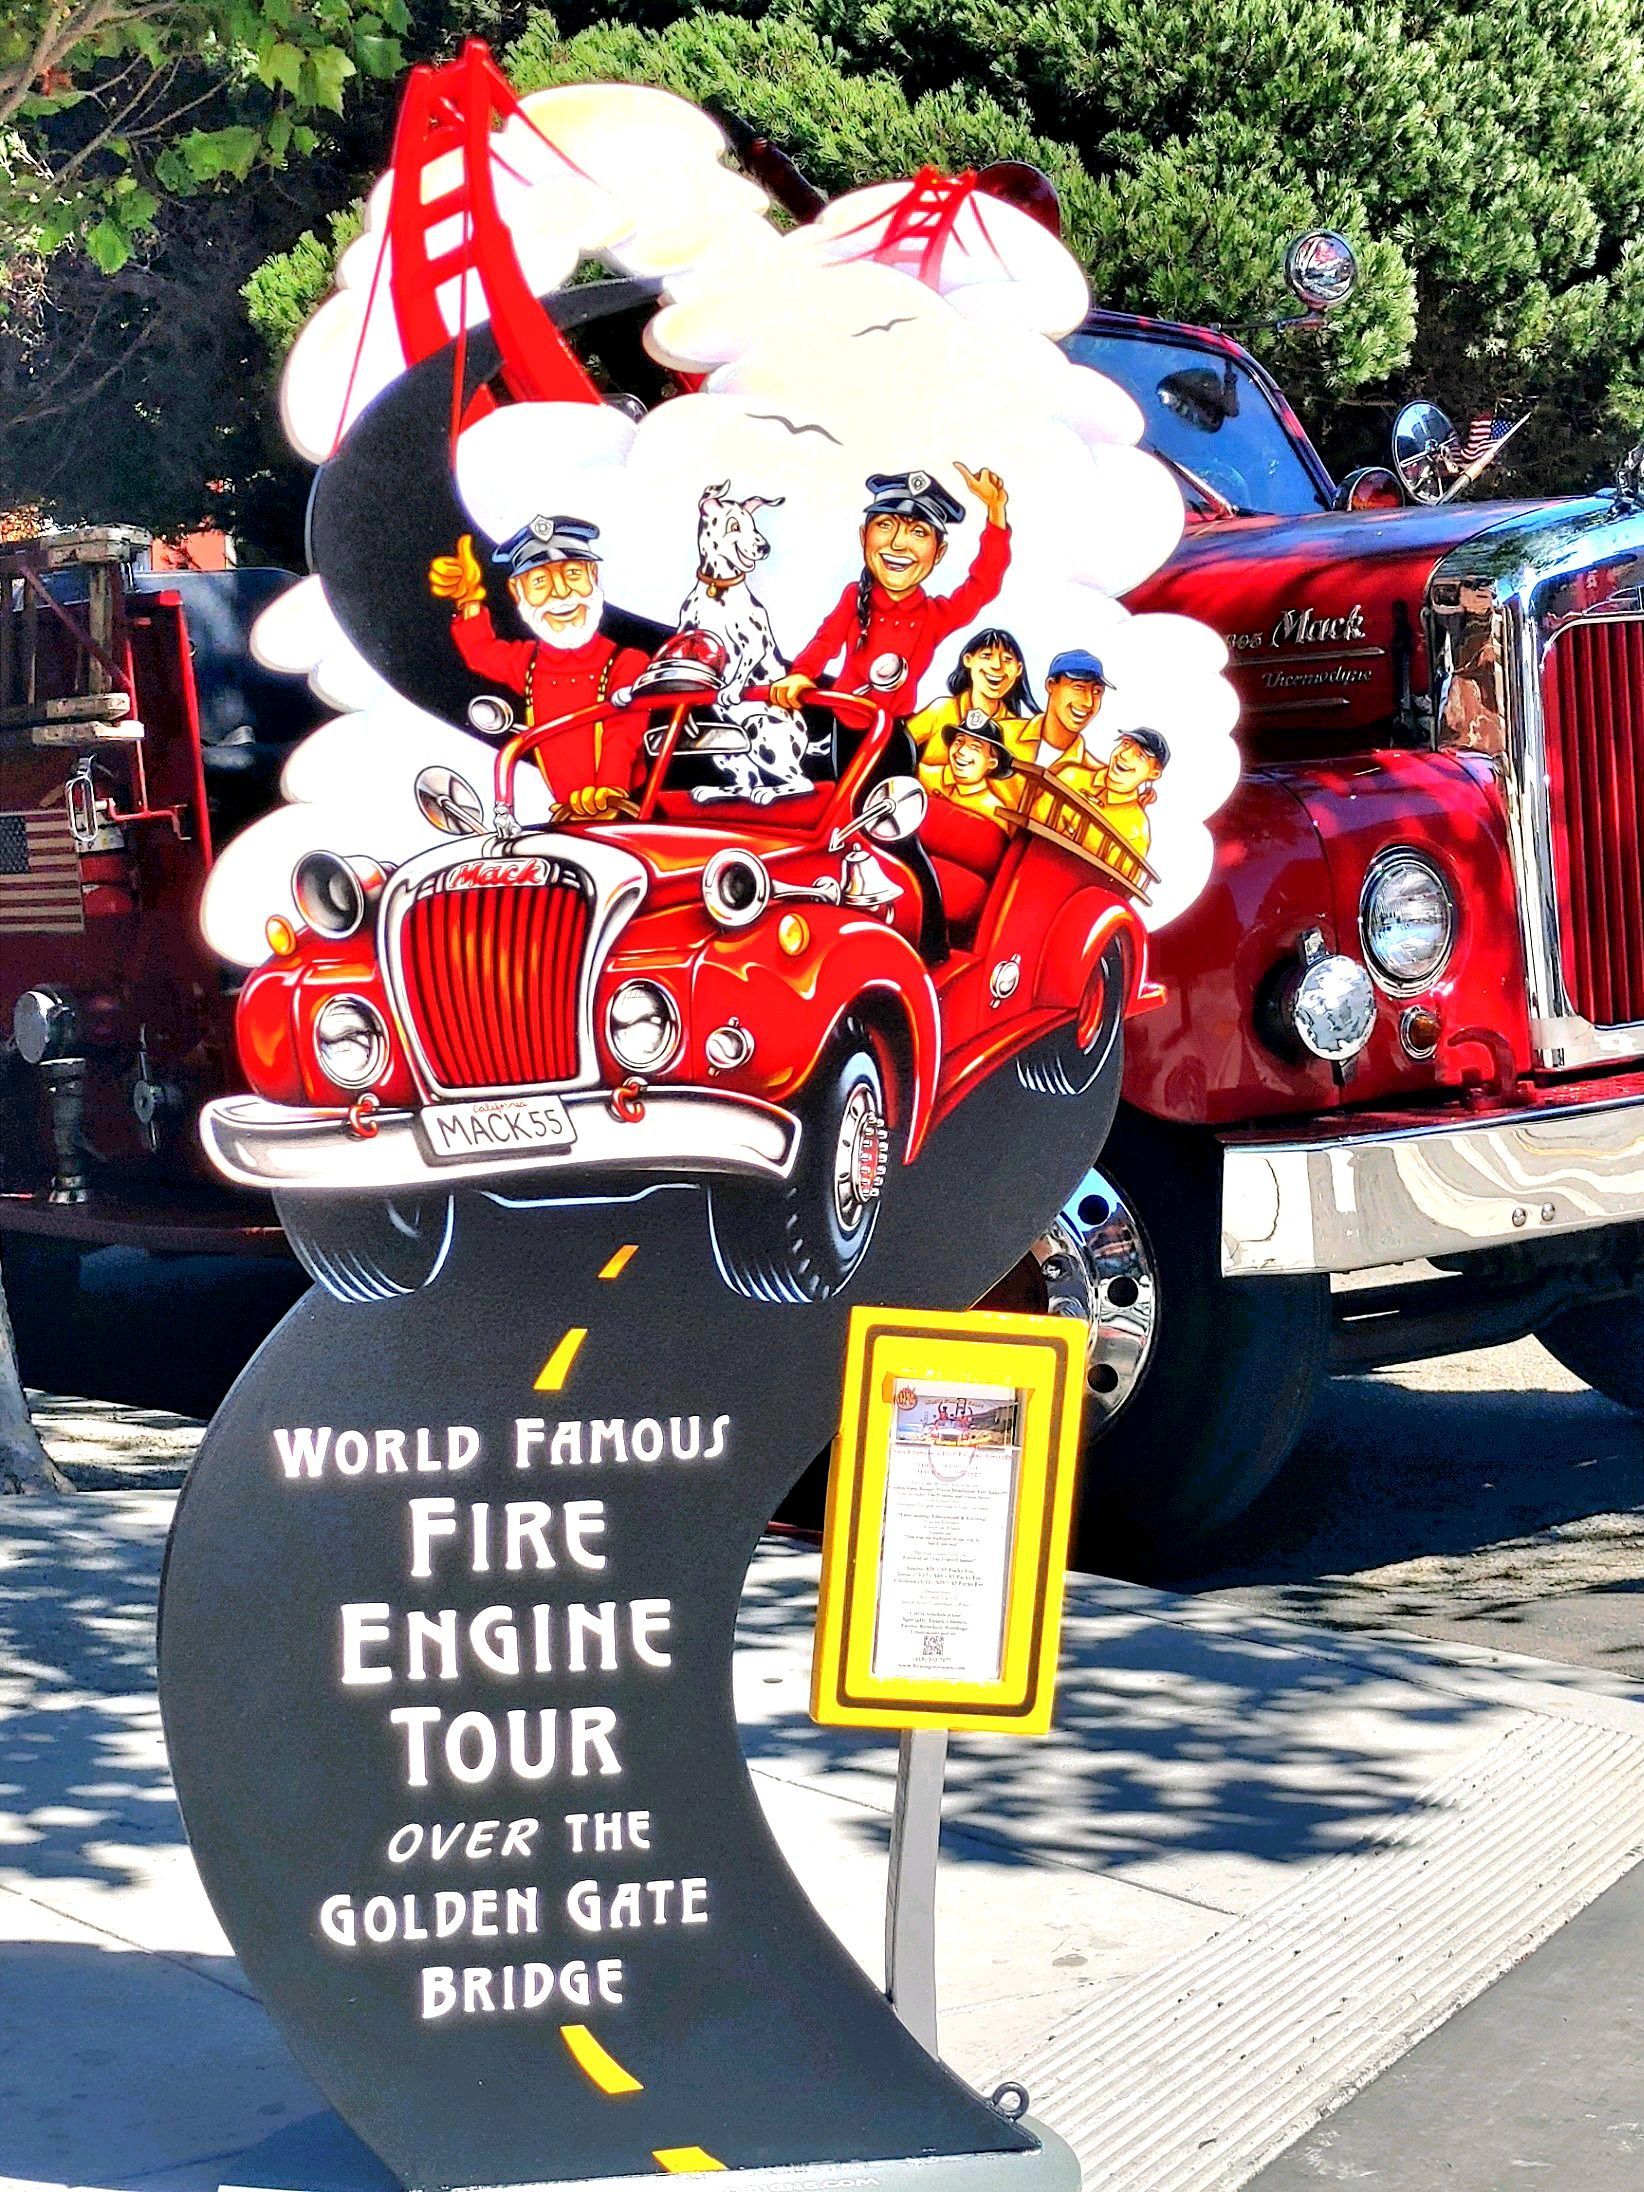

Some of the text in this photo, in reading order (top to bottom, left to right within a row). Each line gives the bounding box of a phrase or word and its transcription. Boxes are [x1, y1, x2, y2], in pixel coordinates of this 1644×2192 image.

[1271, 604, 1367, 648] Mack
[449, 858, 542, 888] Mack
[274, 1415, 729, 1478] WORLD FAMOUS
[409, 1498, 605, 1577] FIRE
[341, 1599, 671, 1685] ENGINE
[391, 1707, 621, 1787] TOUR
[389, 1811, 650, 1862] OVER THE
[321, 1878, 707, 1946] GOLDEN GATE
[422, 1959, 622, 2018] BRIDGE
